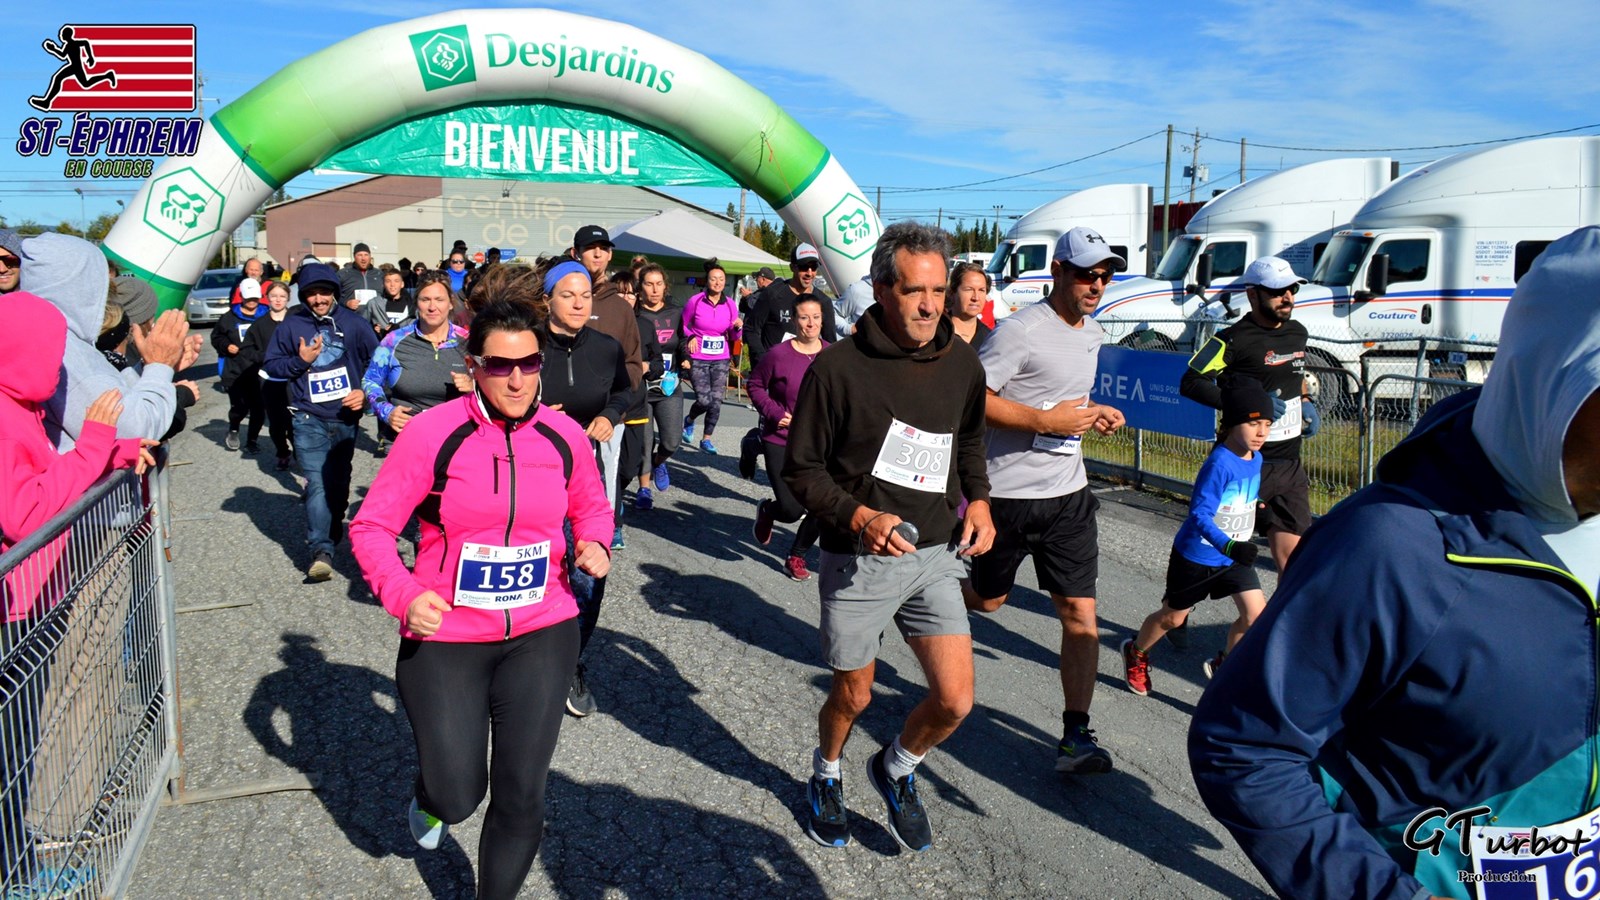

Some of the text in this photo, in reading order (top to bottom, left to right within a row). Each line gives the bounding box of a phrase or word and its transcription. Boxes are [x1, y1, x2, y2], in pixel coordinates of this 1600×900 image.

[485, 33, 675, 94] Desjardins
[444, 121, 640, 176] BIENVENUE
[447, 192, 565, 220] centre
[482, 220, 529, 246] de
[1368, 312, 1416, 320] Couture
[707, 341, 722, 349] 180
[316, 378, 343, 393] 148
[1090, 373, 1146, 402] REA
[1149, 383, 1180, 395] UNIS POU
[1149, 394, 1179, 405] CONCREA.CA
[895, 443, 944, 473] 308
[1219, 515, 1250, 531] 301
[516, 545, 542, 560] 5KM
[478, 563, 534, 590] 158
[494, 593, 523, 603] RONA
[1528, 850, 1600, 900] 16
